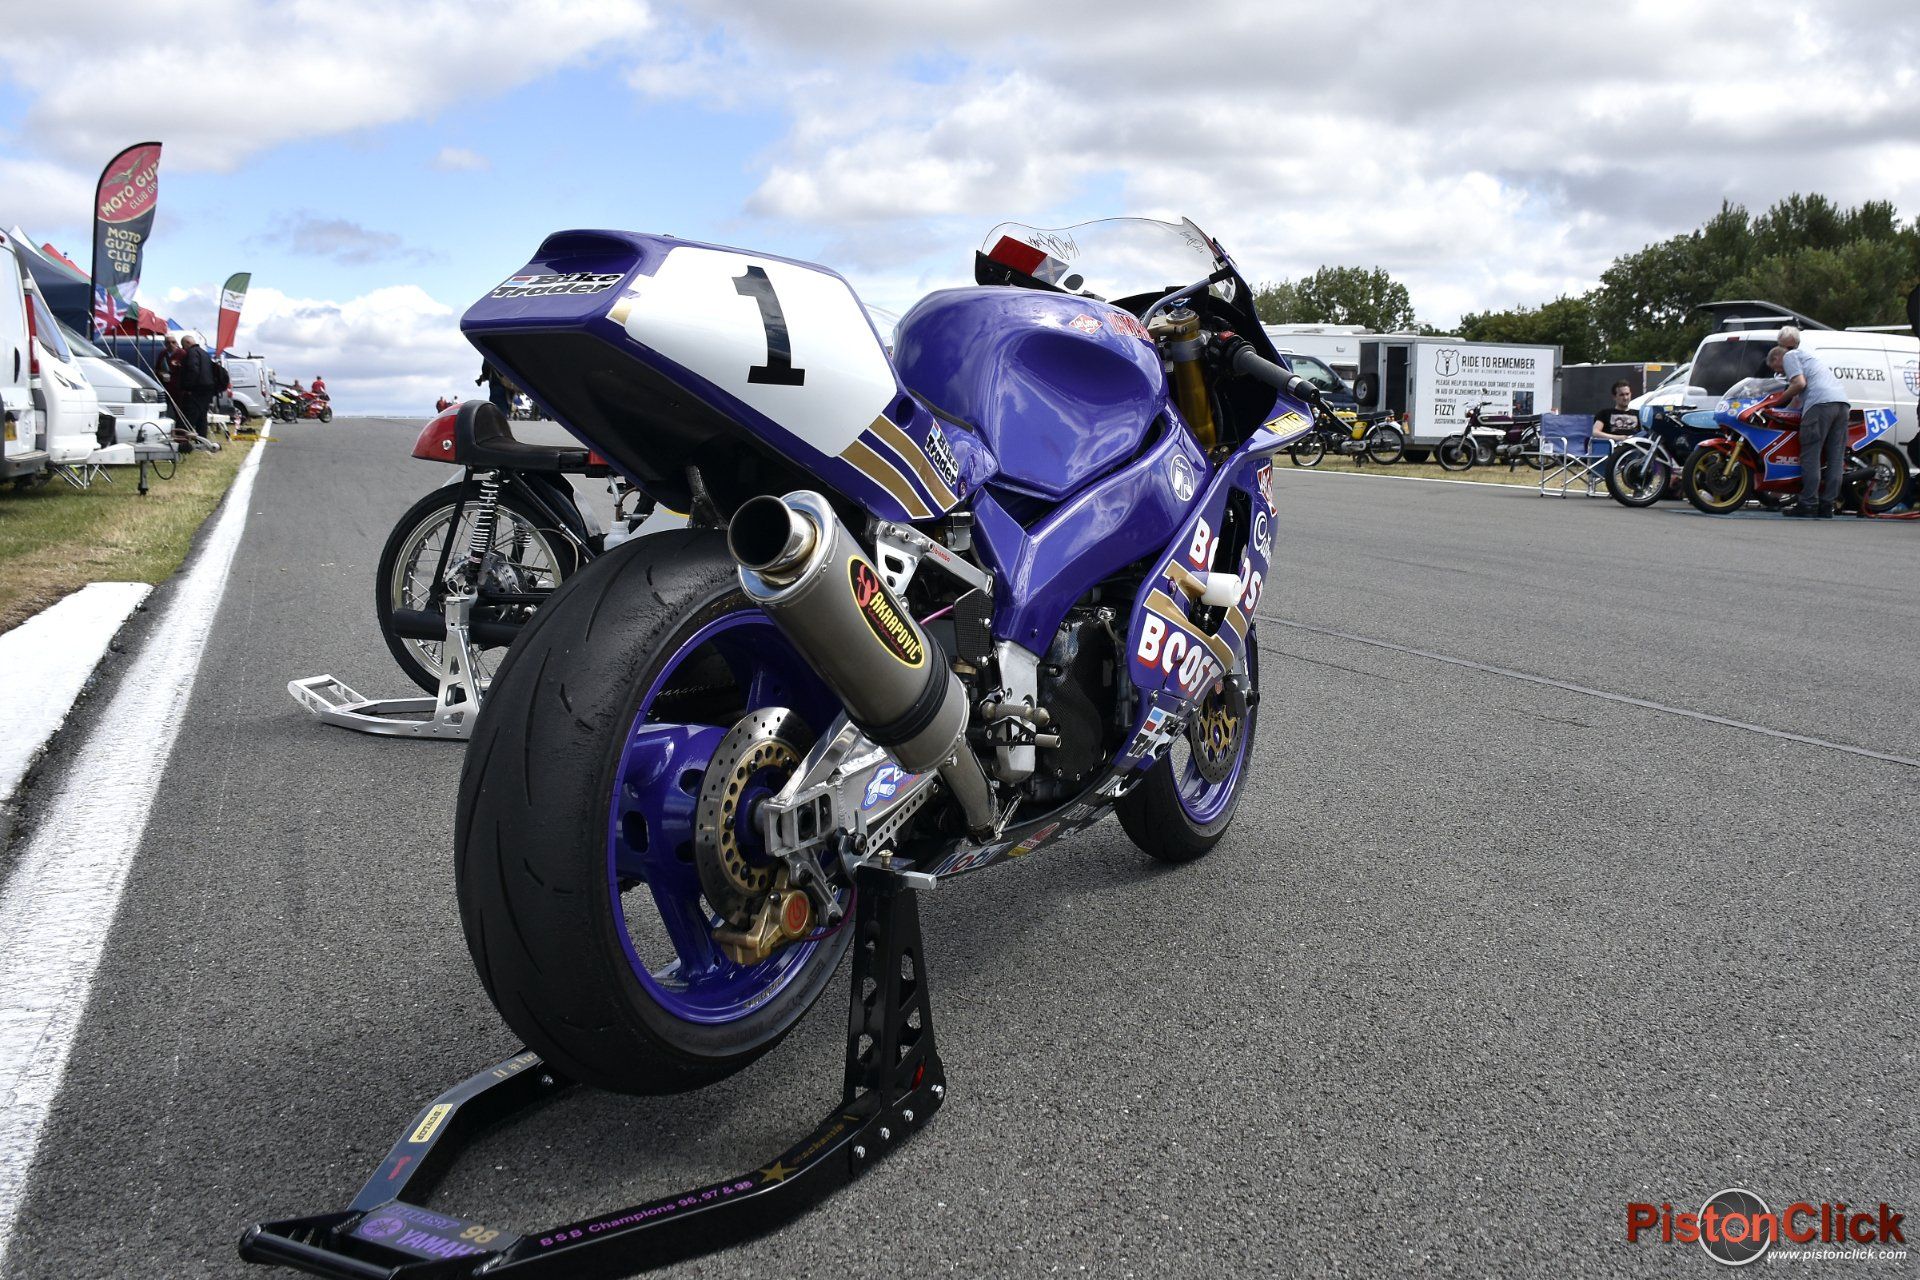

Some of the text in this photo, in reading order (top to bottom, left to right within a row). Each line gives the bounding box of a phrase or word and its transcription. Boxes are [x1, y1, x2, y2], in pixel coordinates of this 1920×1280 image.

[101, 186, 135, 217] MOTO
[129, 191, 148, 210] CLUB
[107, 227, 141, 243] MOTO
[107, 249, 137, 264] CLUB
[114, 262, 131, 273] GB
[529, 272, 621, 285] Bike
[492, 283, 611, 298] Trader
[731, 265, 805, 386] 1
[1462, 356, 1535, 369] RIDE TO REMEMBER
[1434, 405, 1456, 416] FIZZY
[1866, 409, 1889, 433] 53
[925, 434, 957, 485] Trader
[936, 428, 958, 472] Bike
[1137, 612, 1222, 701] BOOST
[417, 1110, 442, 1141] DUNLOP
[588, 1203, 676, 1233] Champions
[722, 1186, 735, 1195] &
[734, 1181, 754, 1191] 98
[460, 1225, 500, 1243] 98
